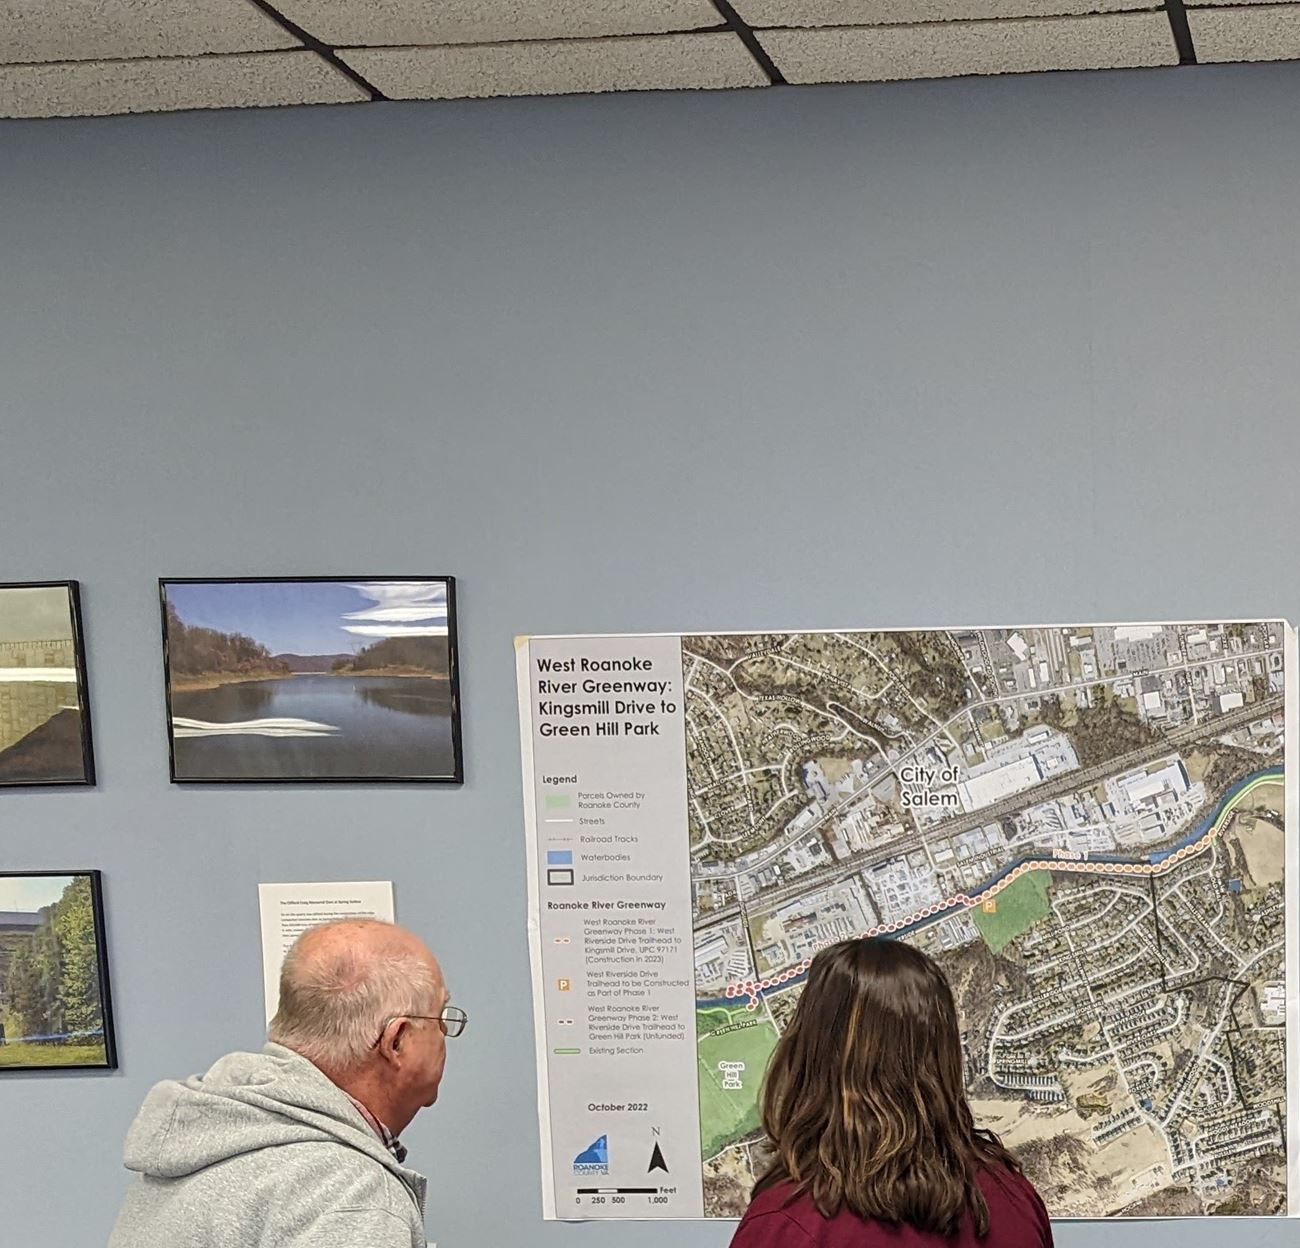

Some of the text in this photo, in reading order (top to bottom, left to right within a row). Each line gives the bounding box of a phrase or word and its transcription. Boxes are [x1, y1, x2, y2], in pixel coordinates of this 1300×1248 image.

[537, 658, 652, 672] West Roanoke
[539, 680, 671, 695] River Greenway:
[540, 701, 676, 717] Kingsmill Drive to
[540, 722, 659, 736] Green Hill Park
[543, 775, 577, 784] Legend
[900, 767, 959, 785] City of
[636, 792, 645, 800] by
[902, 791, 958, 806] Salem
[614, 801, 640, 809] County
[1053, 849, 1080, 860] Phase
[627, 874, 662, 882] Boundary
[548, 900, 666, 910] Roanoke River Greenway
[651, 1127, 660, 1136] N
